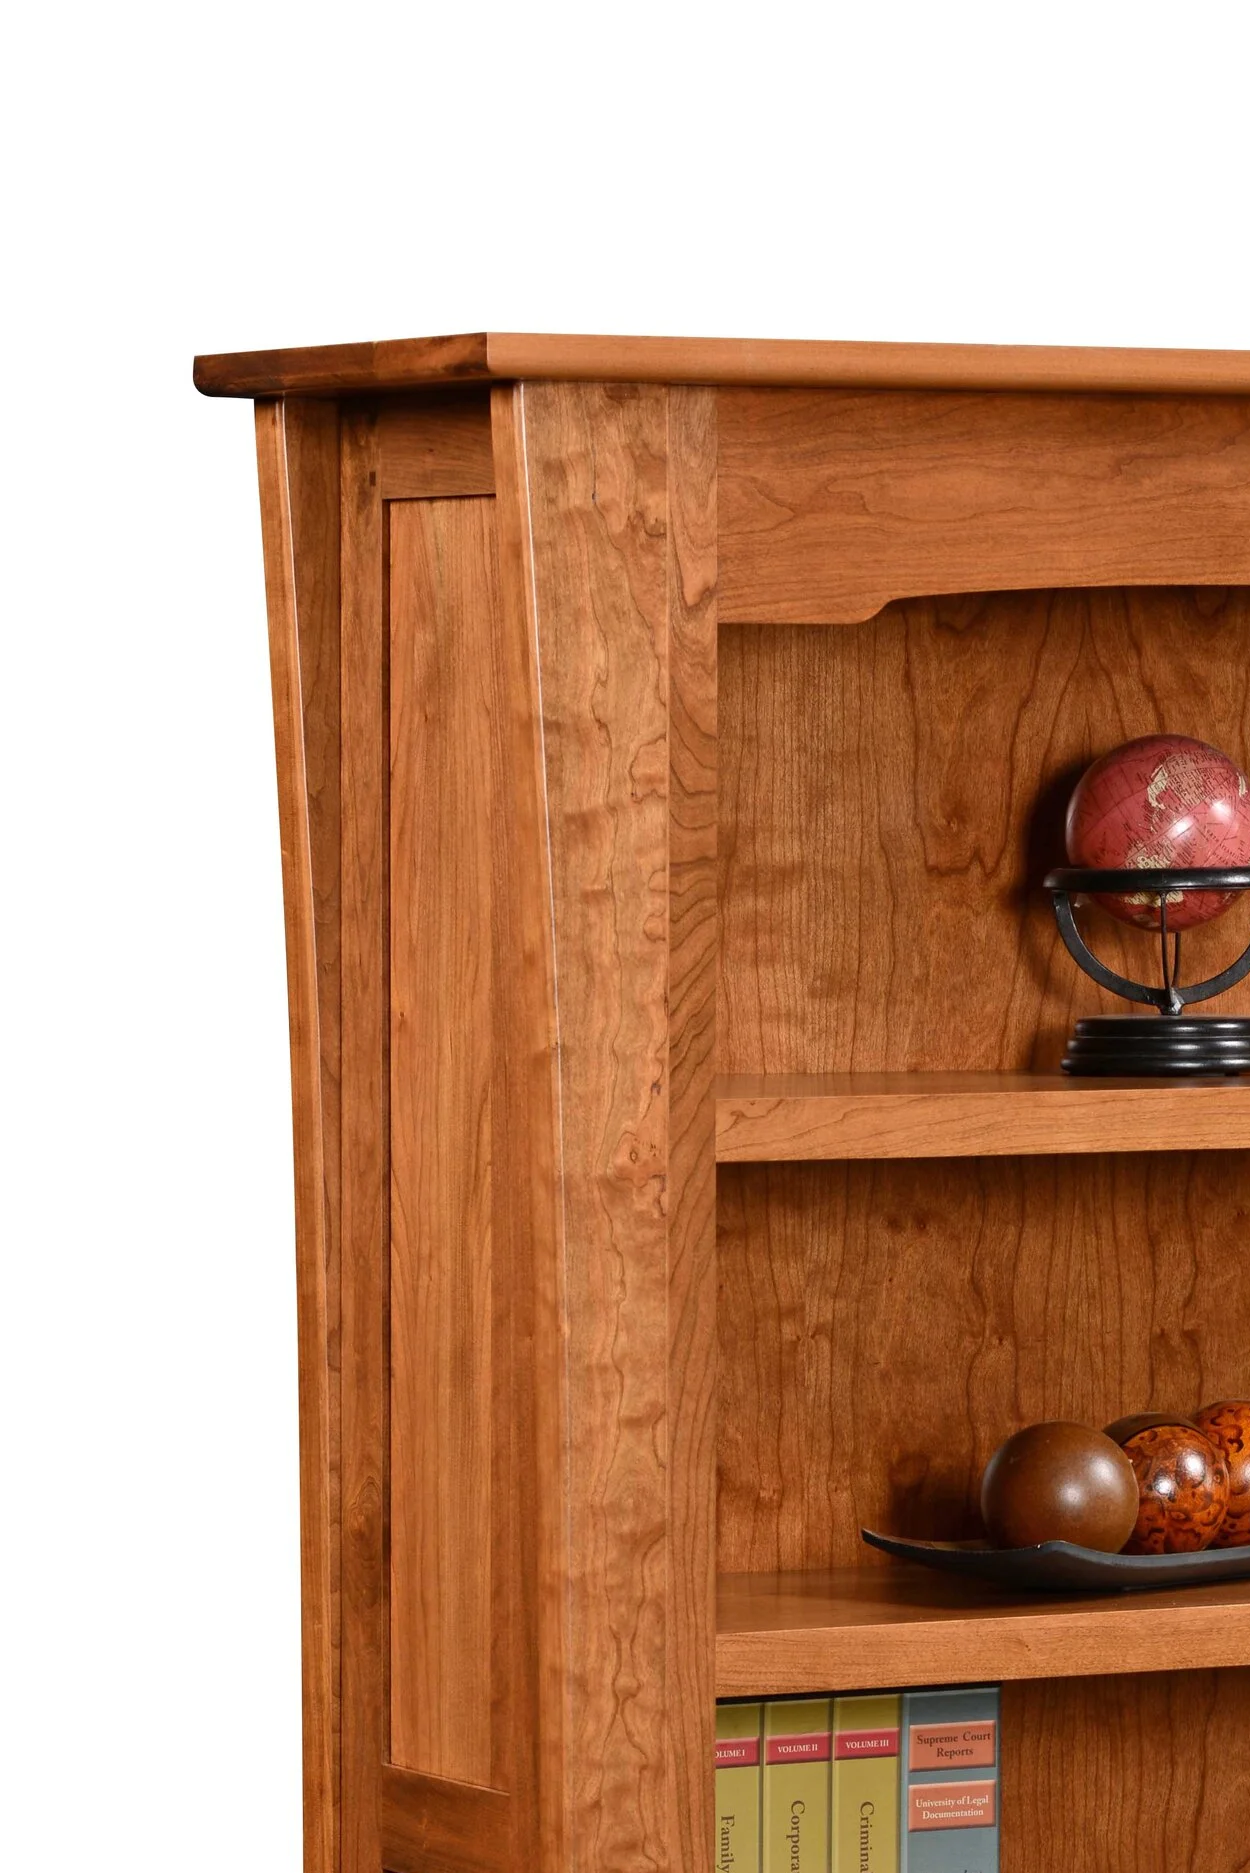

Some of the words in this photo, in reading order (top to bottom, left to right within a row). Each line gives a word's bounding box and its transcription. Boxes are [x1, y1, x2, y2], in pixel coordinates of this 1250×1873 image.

[845, 1741, 879, 1749] VOLUME
[879, 1739, 889, 1747] III
[916, 1734, 958, 1747] Supreme
[962, 1731, 991, 1742] Court
[715, 1749, 741, 1758] OLUME
[777, 1744, 811, 1753] VOLUME
[936, 1747, 974, 1760] Reports
[916, 1798, 955, 1809] University
[956, 1796, 966, 1805] of
[966, 1795, 989, 1806] Legal
[922, 1808, 984, 1820] Documentation
[716, 1815, 735, 1873] Family
